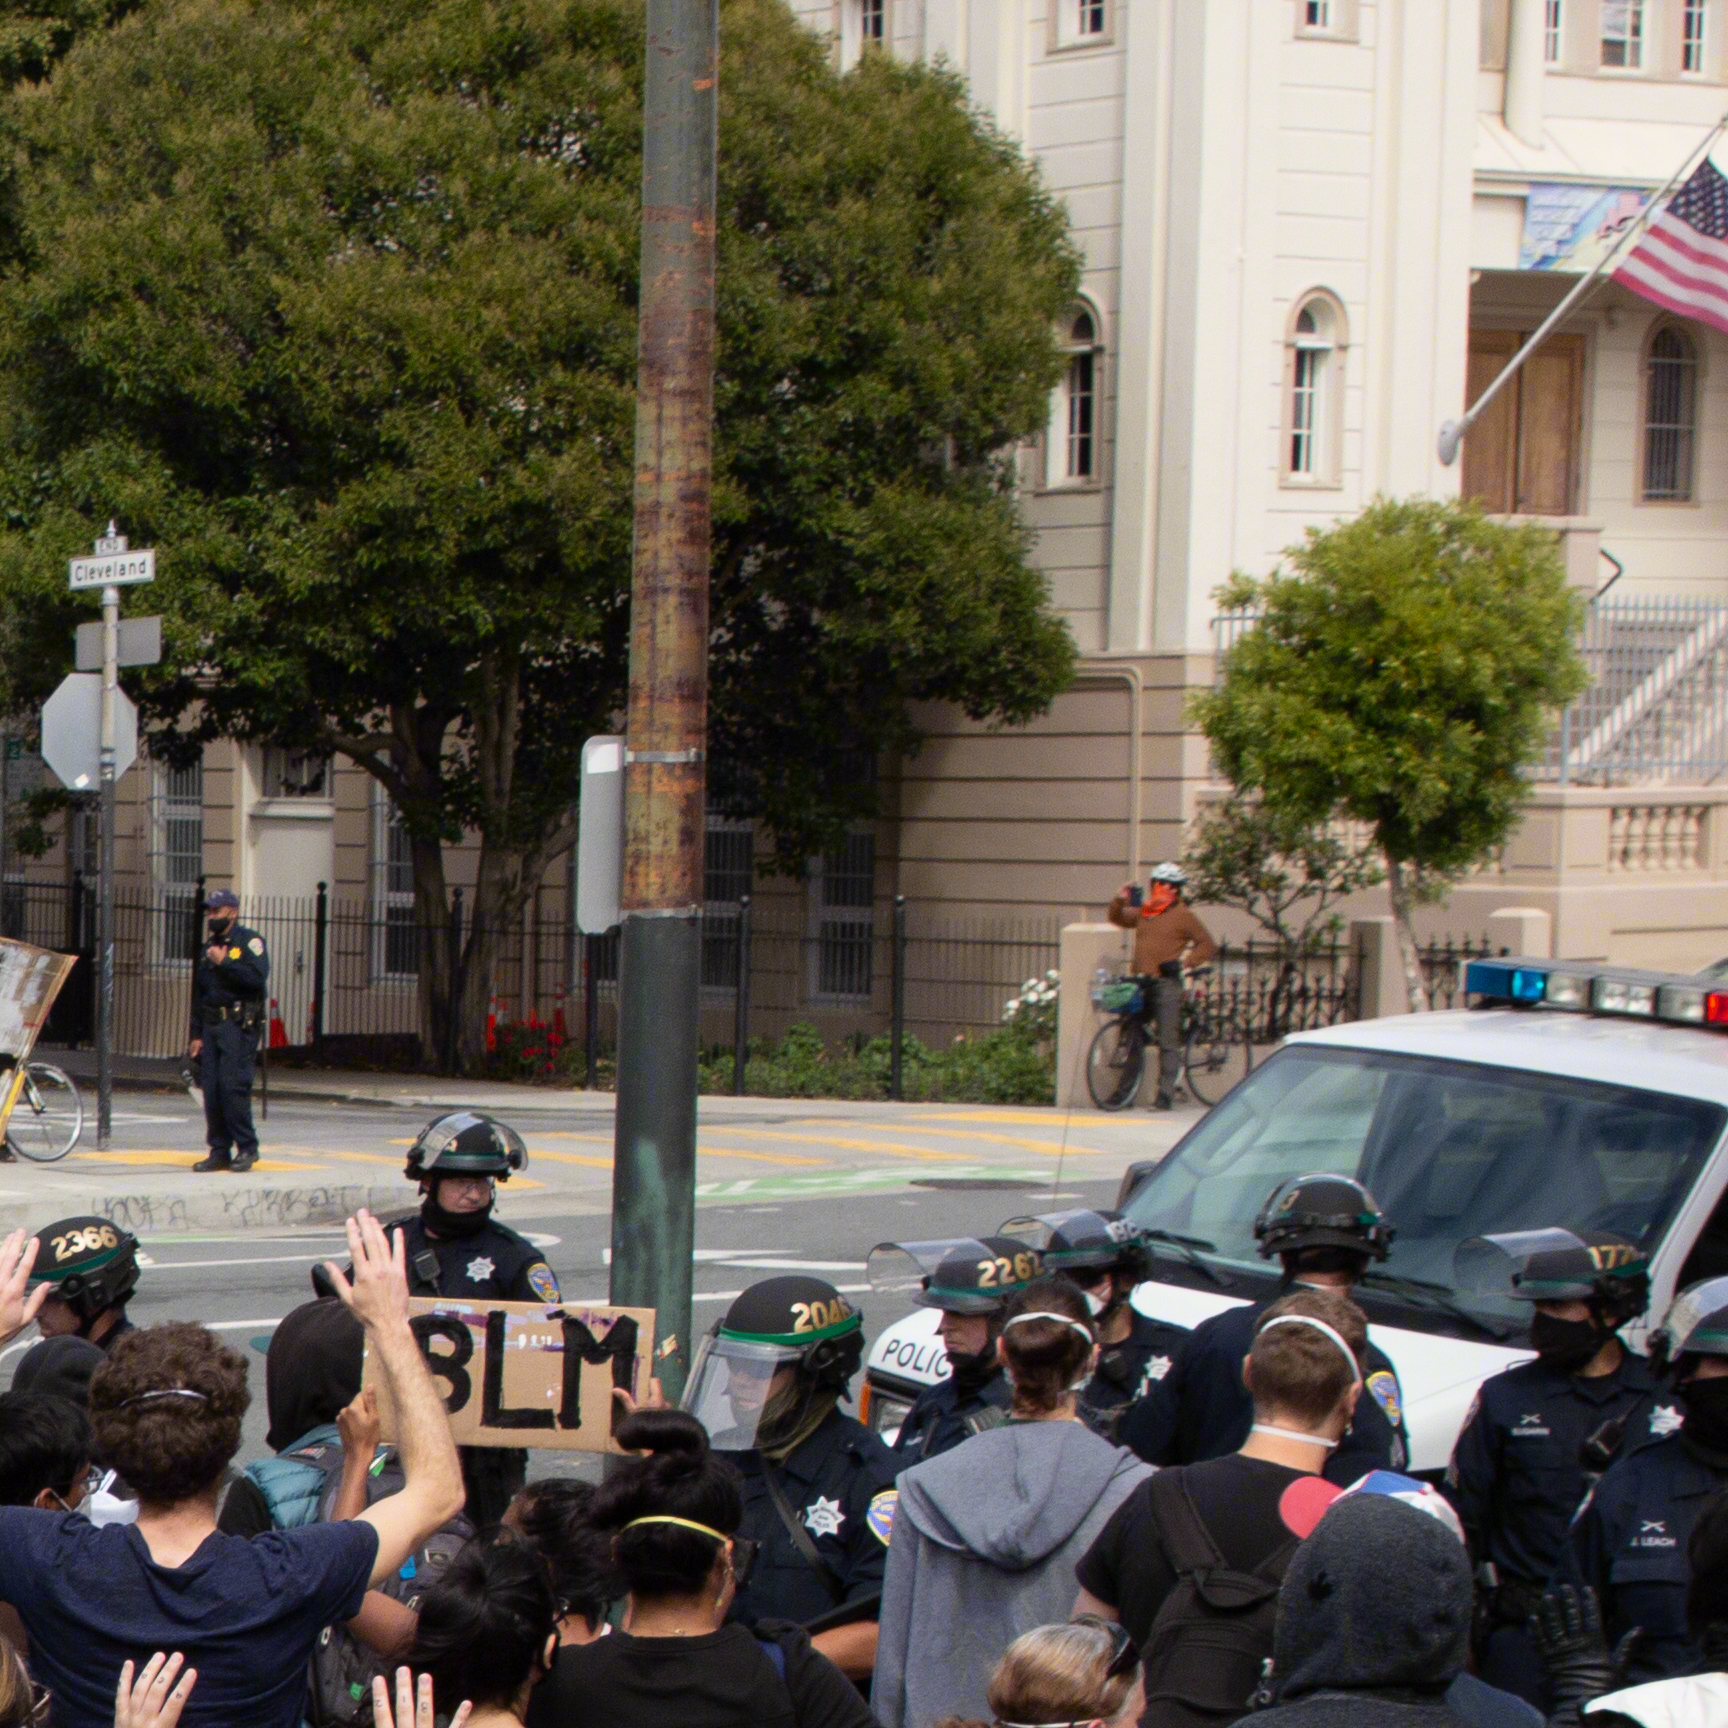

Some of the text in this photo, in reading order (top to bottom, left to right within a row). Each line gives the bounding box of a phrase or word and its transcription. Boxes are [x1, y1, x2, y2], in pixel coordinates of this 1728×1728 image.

[74, 557, 147, 581] Cleveland
[50, 1225, 118, 1262] 2366
[407, 1309, 639, 1438] BLM
[882, 1338, 952, 1378] POLIC
